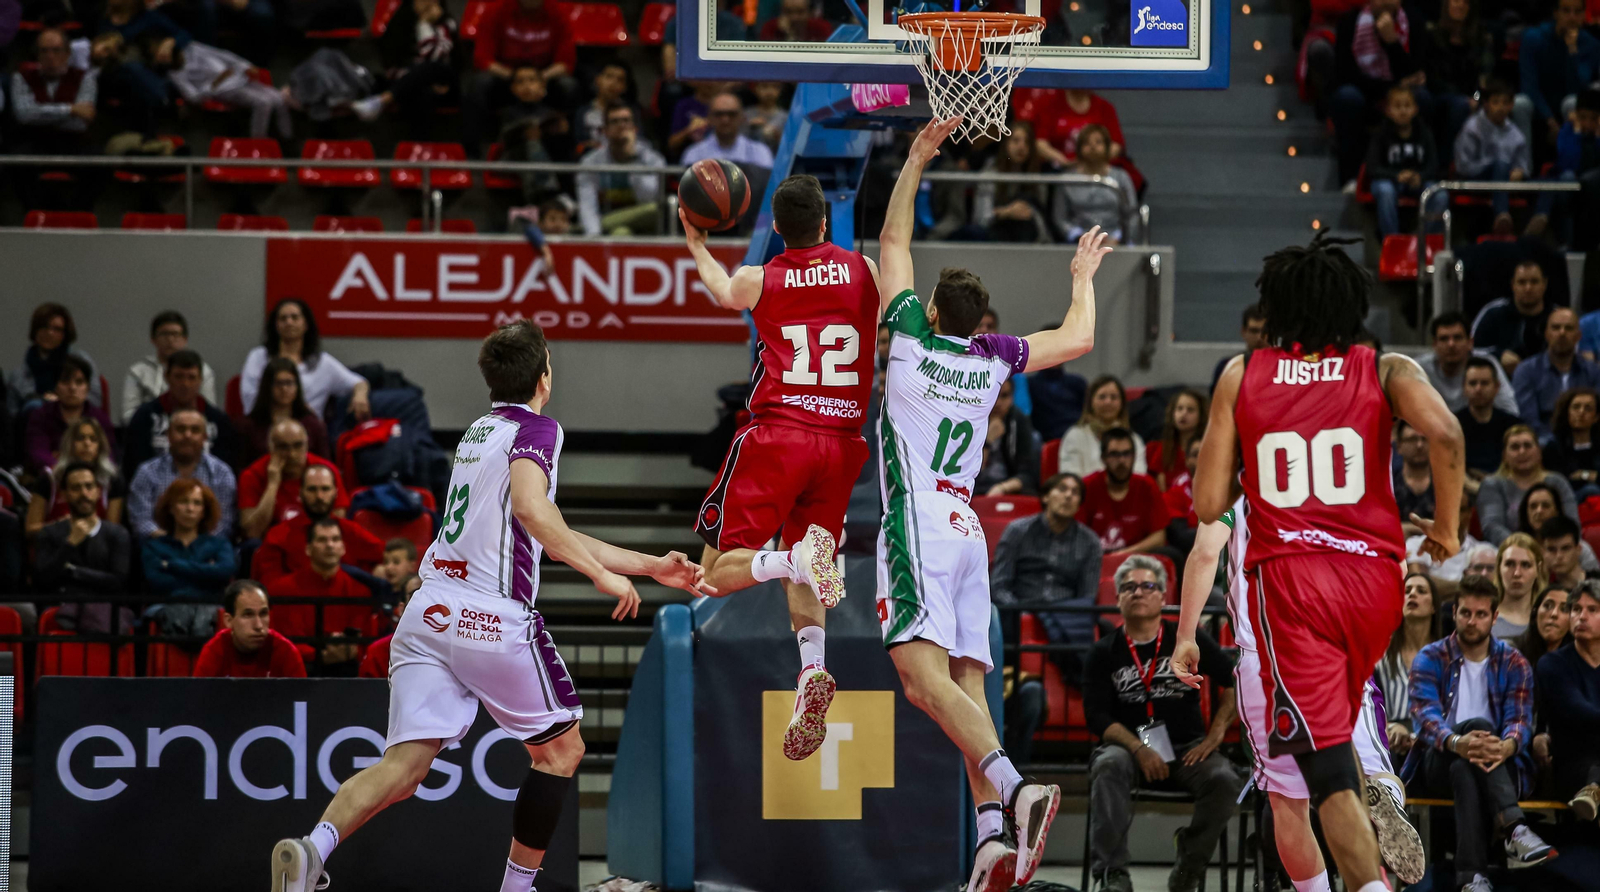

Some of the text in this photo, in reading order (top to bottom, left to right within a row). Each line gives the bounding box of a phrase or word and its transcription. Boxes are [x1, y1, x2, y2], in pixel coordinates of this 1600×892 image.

[1146, 11, 1160, 22] liga
[1146, 21, 1184, 31] endesa
[329, 252, 742, 307] ALEJANDR
[784, 259, 850, 288] ALOCÉN
[493, 310, 625, 329] MODA
[781, 324, 860, 386] 12
[1273, 357, 1345, 385] JUSTIZ
[801, 394, 858, 409] GOBIERNO
[803, 403, 863, 418] DE ARAGON
[930, 417, 974, 476] 12
[1256, 426, 1366, 509] 00
[461, 608, 502, 624] COSTA
[458, 619, 503, 633] DEL SOL
[457, 629, 503, 643] MÁLAGA
